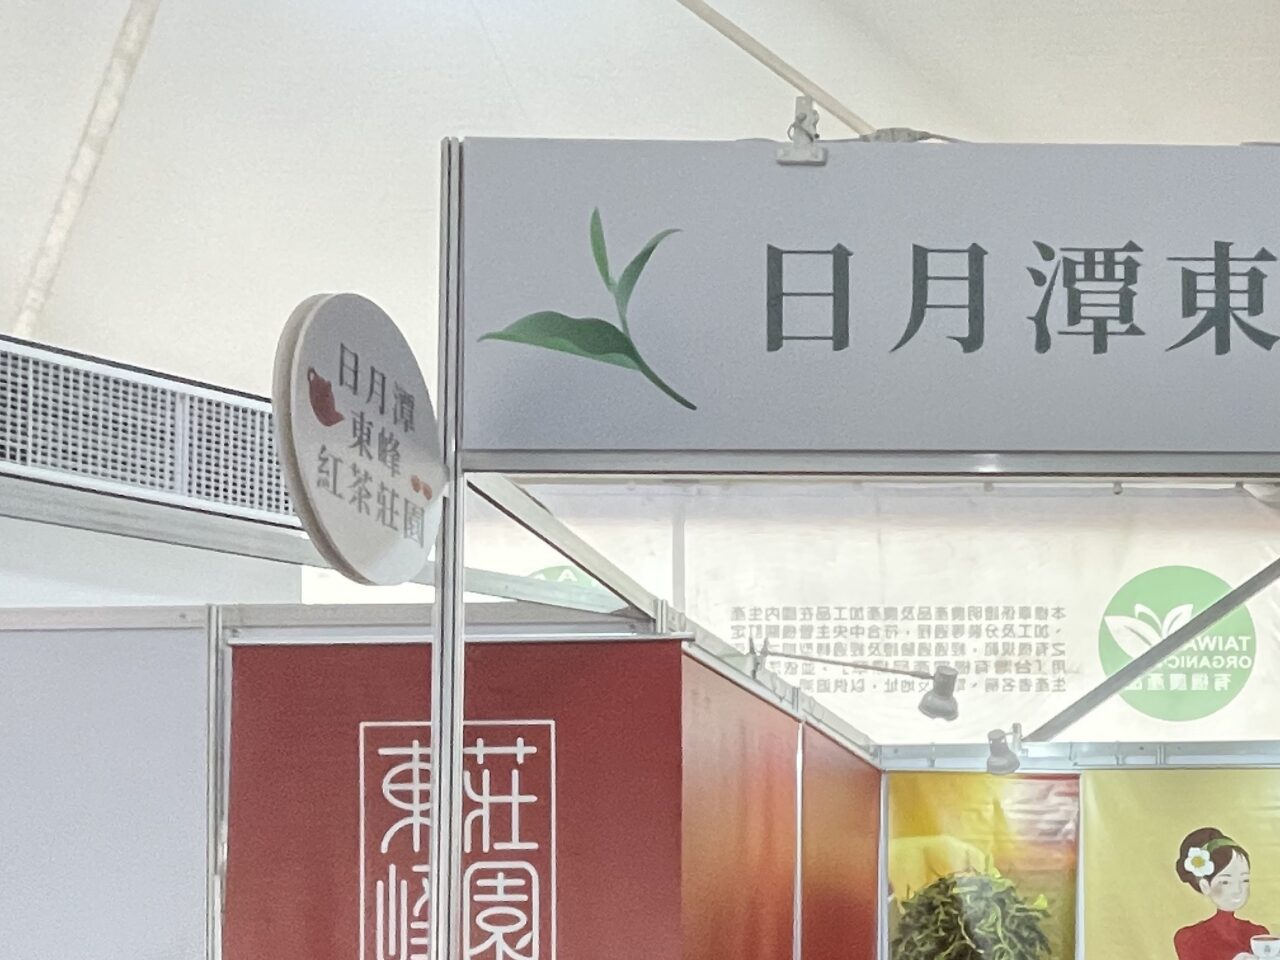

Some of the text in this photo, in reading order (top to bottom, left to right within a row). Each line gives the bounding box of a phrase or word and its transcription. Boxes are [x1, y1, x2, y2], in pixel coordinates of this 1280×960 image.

[338, 343, 415, 434] 日月潭
[347, 410, 402, 480] 東峰
[316, 445, 426, 549] 紅茶莊園
